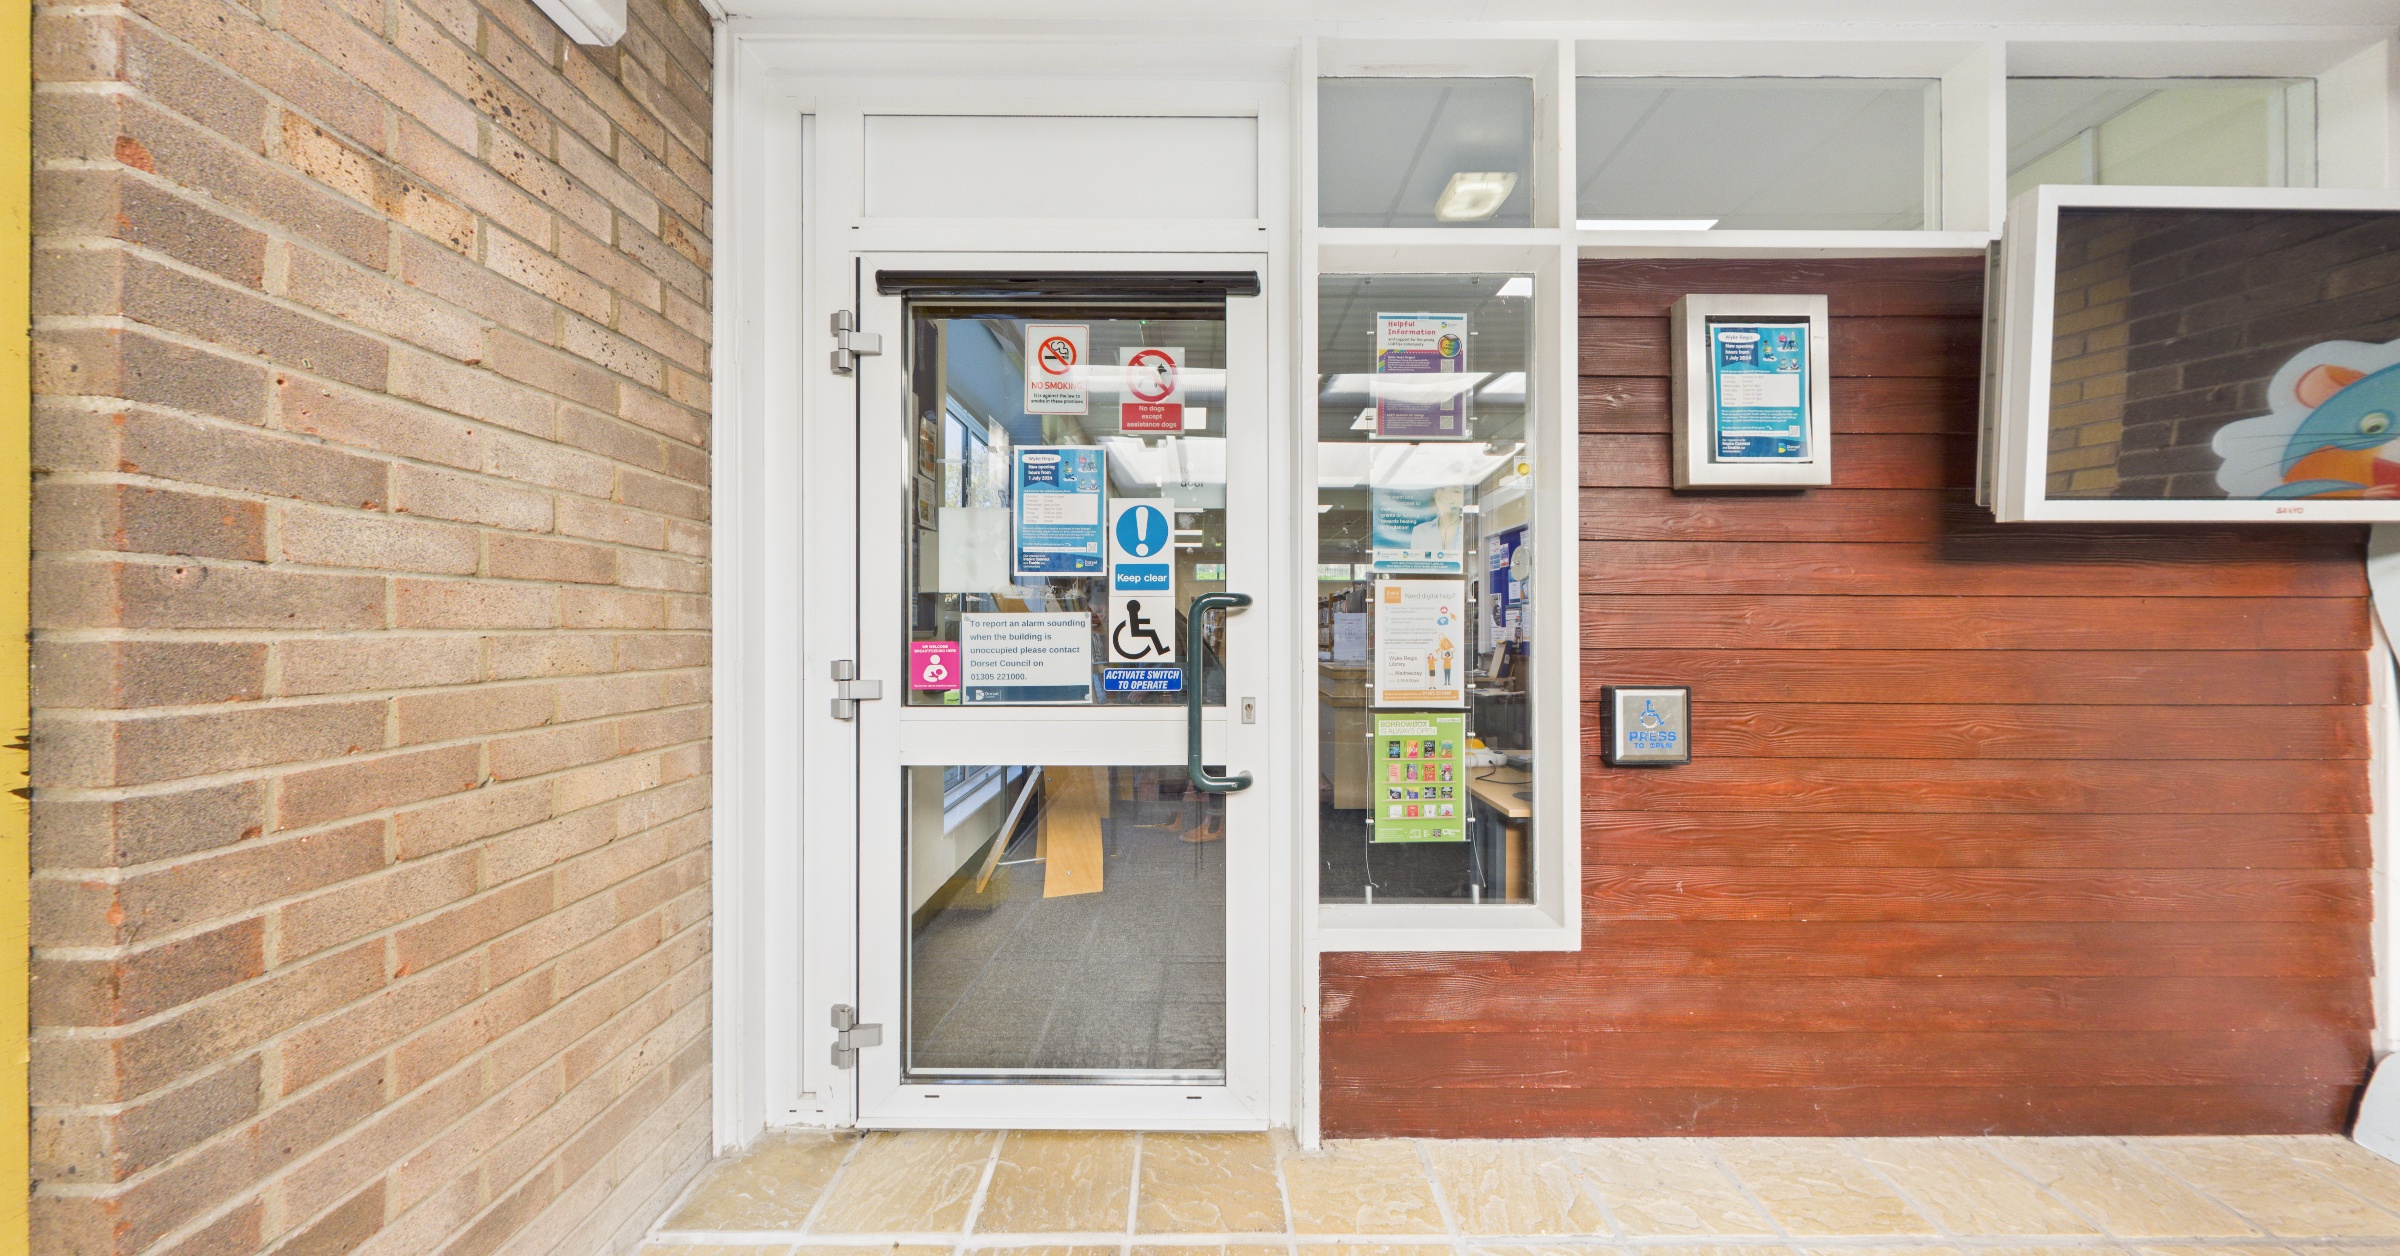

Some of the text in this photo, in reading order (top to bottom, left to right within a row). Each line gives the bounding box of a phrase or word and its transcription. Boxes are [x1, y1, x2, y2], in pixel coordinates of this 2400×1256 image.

[1031, 381, 1043, 389] NO
[1117, 574, 1167, 584] Keep clear
[983, 620, 1007, 629] report
[1047, 620, 1086, 628] sounding
[1009, 633, 1042, 641] building
[970, 647, 1018, 655] unoccupied
[1020, 647, 1046, 655] please
[1106, 670, 1179, 679] ACTIVATE SWITCH
[1118, 681, 1168, 689] TO OPERATE
[1629, 731, 1676, 741] PRESS
